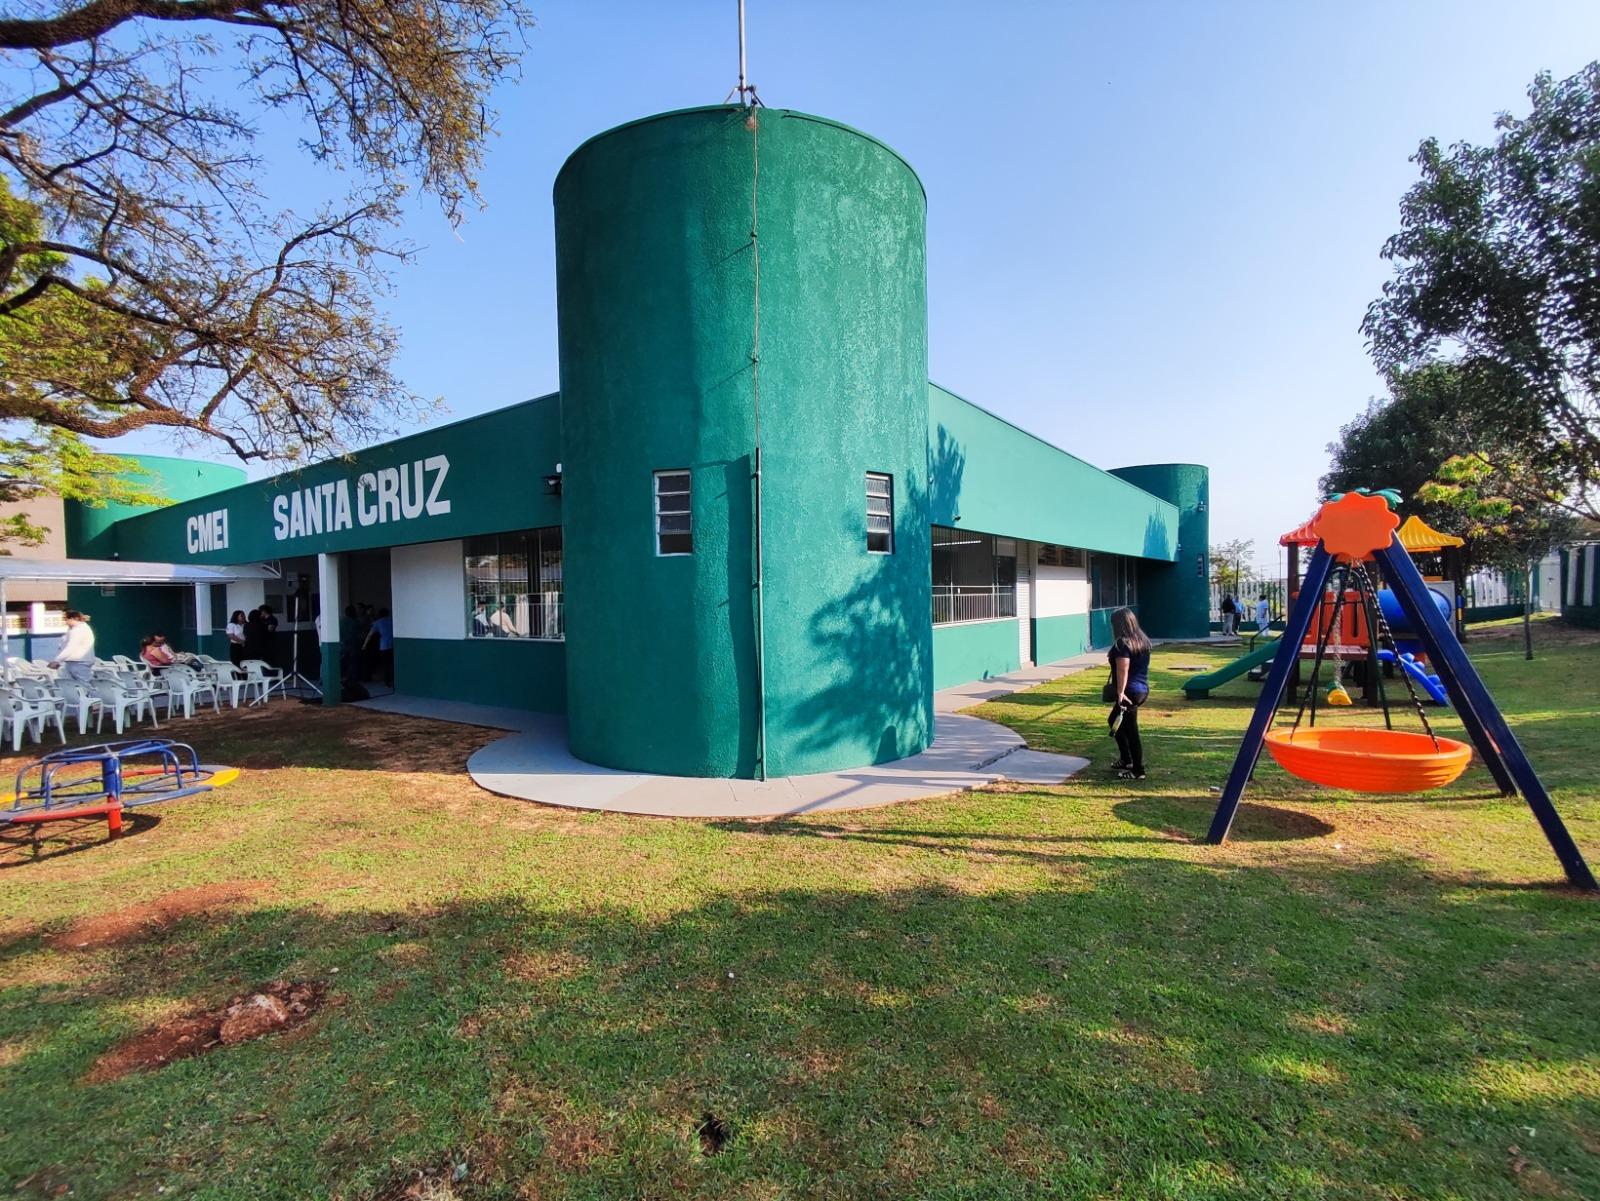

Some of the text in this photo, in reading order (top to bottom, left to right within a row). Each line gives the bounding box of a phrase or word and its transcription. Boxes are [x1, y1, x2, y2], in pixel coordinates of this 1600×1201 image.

[187, 454, 450, 554] CMEI SANTA CRUZ
